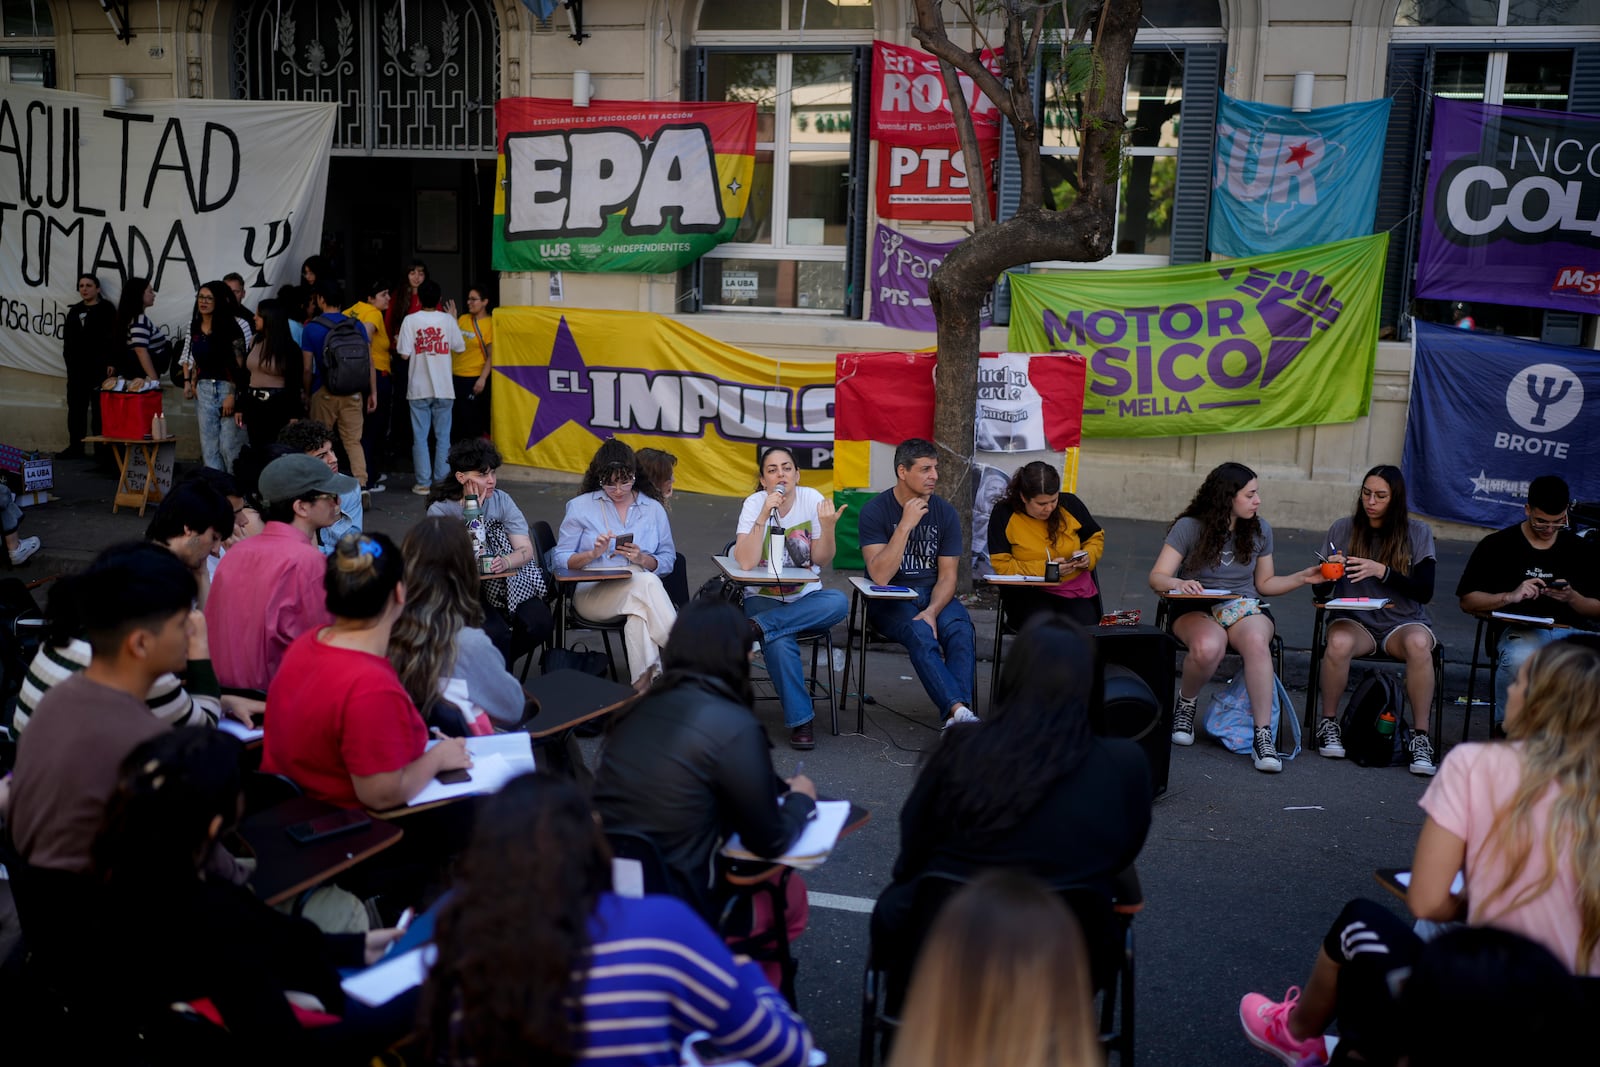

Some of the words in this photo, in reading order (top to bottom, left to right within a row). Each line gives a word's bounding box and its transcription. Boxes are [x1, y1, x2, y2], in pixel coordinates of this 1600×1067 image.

[881, 48, 914, 73] En
[533, 117, 585, 126] ESTUDIANTES
[598, 113, 646, 122] PSICOLOGÍA
[909, 122, 923, 132] PTS
[928, 121, 956, 132] Indepe
[889, 147, 972, 189] PTS
[506, 124, 725, 240] EPA
[540, 243, 571, 257] UJS
[1557, 269, 1600, 293] MS
[880, 287, 910, 308] PTS
[1042, 299, 1246, 346] MOTOR
[1089, 338, 1262, 397] SICO
[549, 369, 588, 393] EL
[1118, 395, 1193, 418] MELLA
[1494, 431, 1570, 460] BROTE
[812, 448, 835, 469] P
[27, 470, 36, 478] LA
[37, 468, 50, 477] UBA
